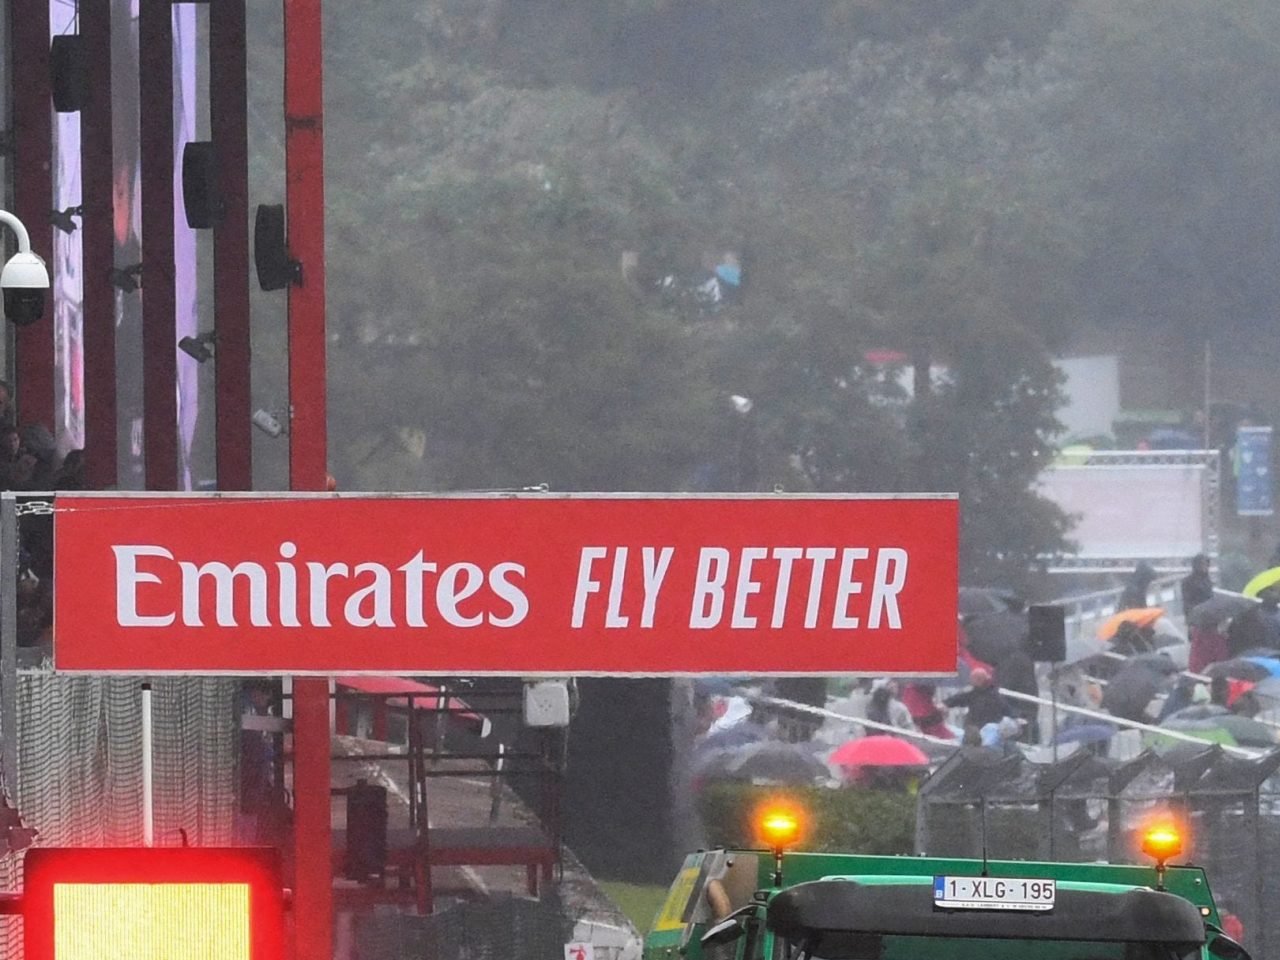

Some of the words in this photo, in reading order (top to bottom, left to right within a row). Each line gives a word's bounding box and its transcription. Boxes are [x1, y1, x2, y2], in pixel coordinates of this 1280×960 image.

[112, 542, 529, 629] Emirates
[572, 547, 675, 629] FLY
[689, 547, 909, 629] BETTER
